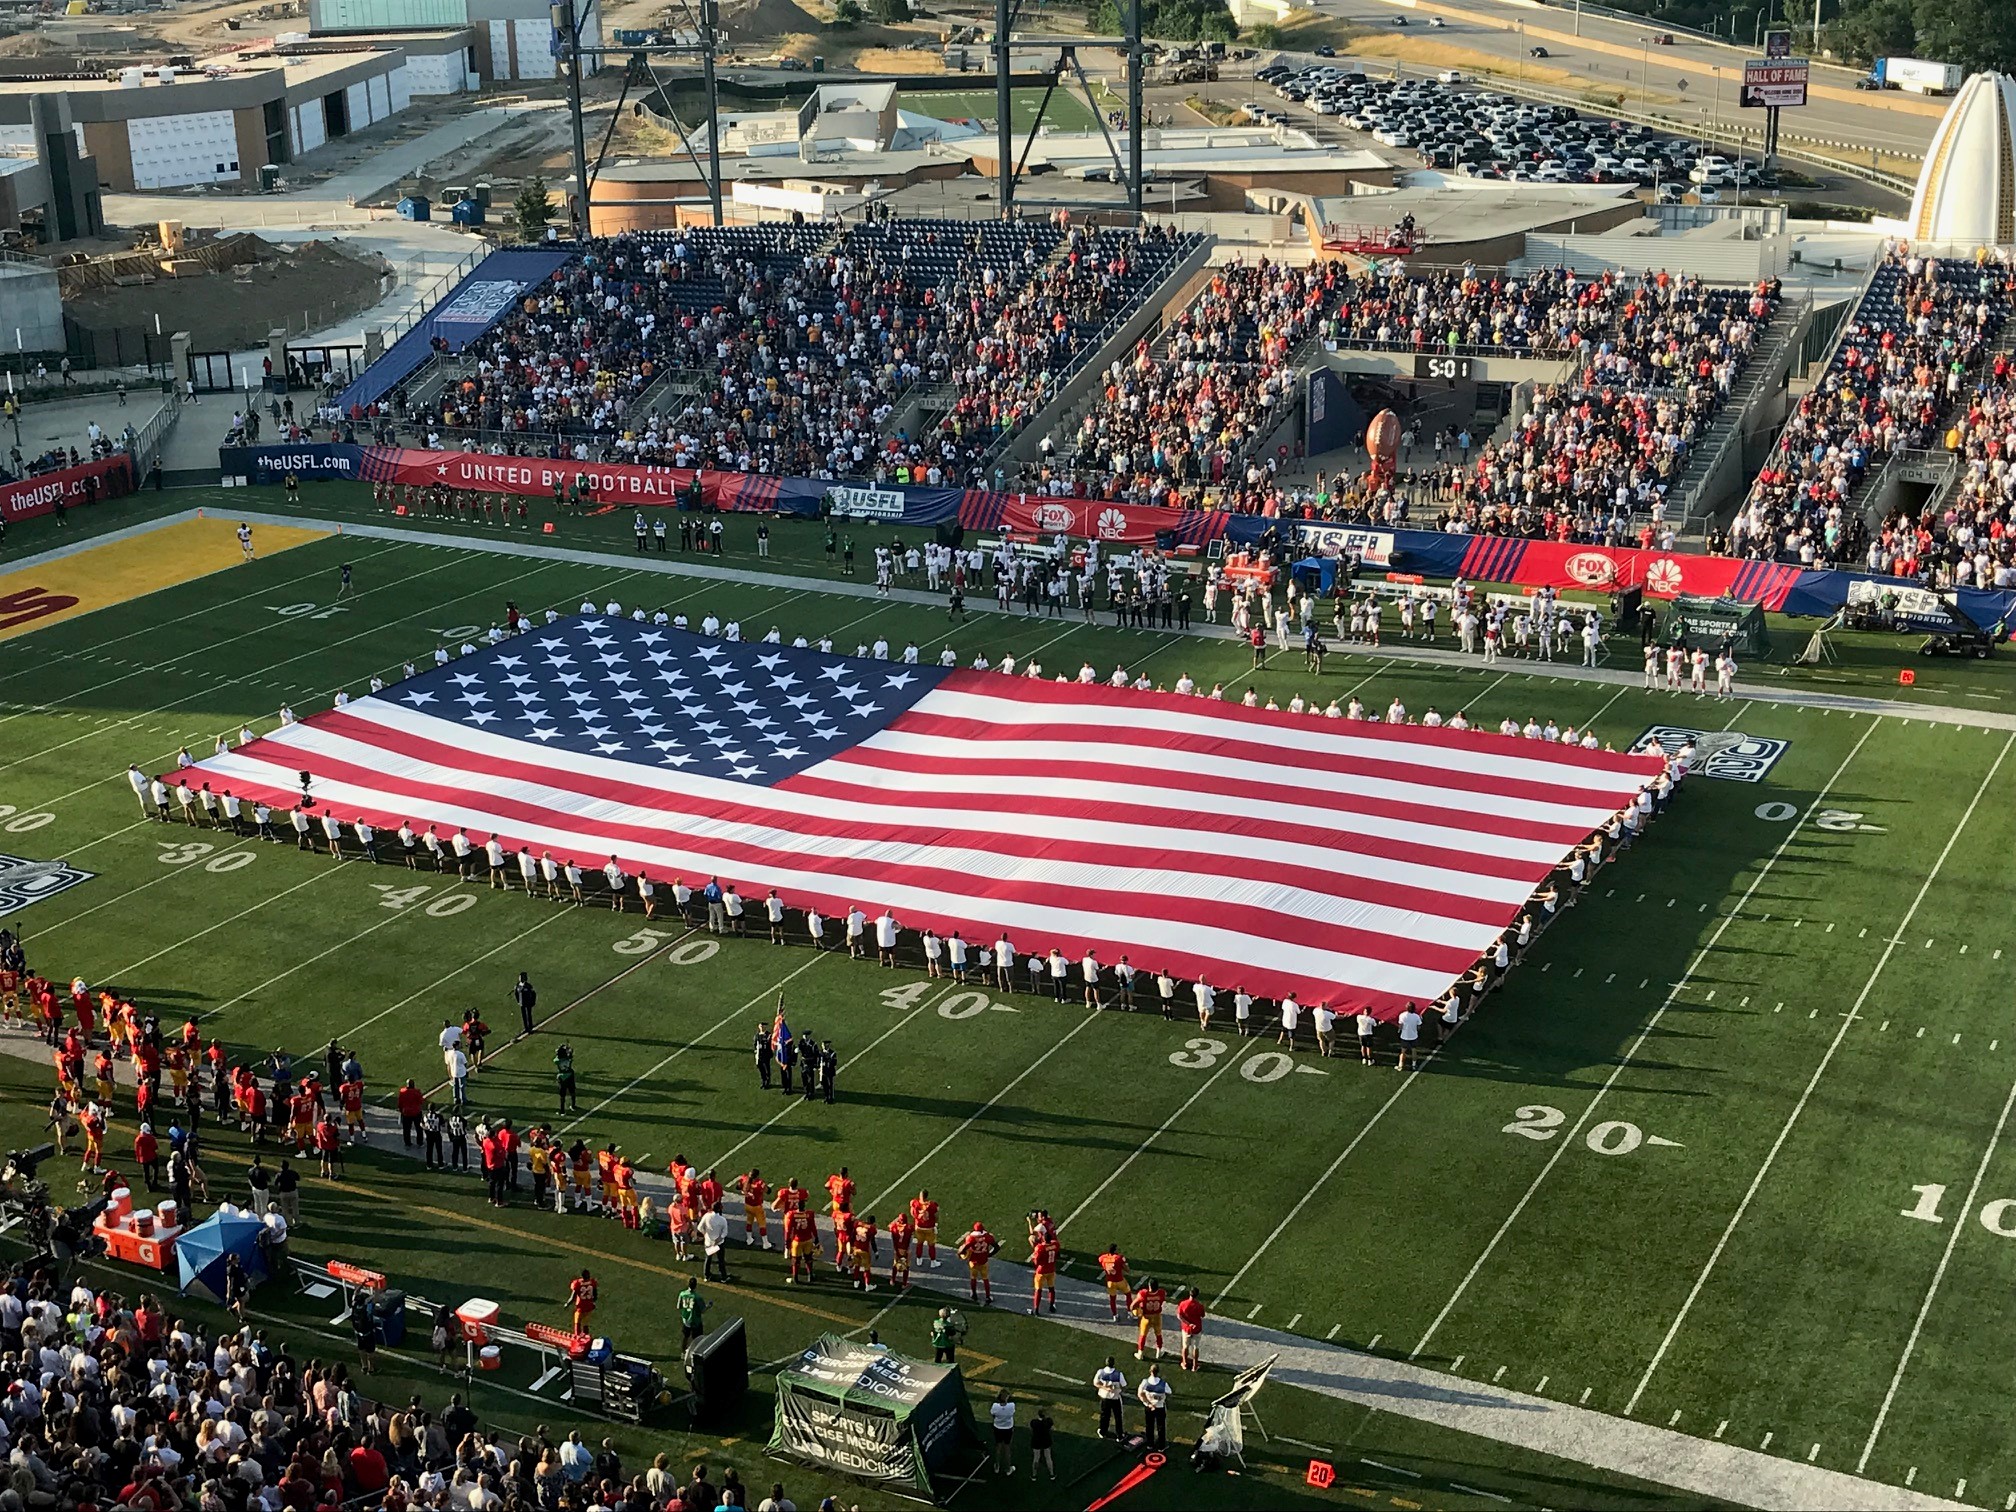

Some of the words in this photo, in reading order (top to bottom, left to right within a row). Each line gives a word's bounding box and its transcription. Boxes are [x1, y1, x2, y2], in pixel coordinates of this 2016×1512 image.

[1747, 70, 1769, 83] HALL
[1770, 69, 1782, 82] OF
[1784, 68, 1807, 81] FAME
[1428, 358, 1468, 378] 5:01
[257, 455, 351, 471] theUSFL.com
[460, 463, 533, 485] UNITED
[541, 470, 567, 487] BY
[853, 492, 901, 510] USFL
[1042, 508, 1066, 522] FOX
[1098, 527, 1125, 540] NBC
[1298, 529, 1387, 562] USFL
[1074, 555, 1082, 564] G
[1576, 558, 1606, 574] FOX
[1647, 578, 1680, 594] NBC
[1893, 612, 1954, 625] AMPIONSHIP
[157, 841, 258, 873] 30
[378, 884, 479, 918] 40
[611, 927, 721, 966] 50
[879, 980, 993, 1020] 40
[1168, 1037, 1295, 1083] 30
[1501, 1104, 1642, 1156] 20
[1900, 1182, 2016, 1238] 10
[138, 1243, 155, 1263] G
[463, 1321, 478, 1338] G
[803, 1350, 870, 1369] EXERCISE
[868, 1361, 939, 1390] MEDICINE
[845, 1351, 900, 1369] SPORTS
[898, 1364, 911, 1375] &
[833, 1371, 918, 1401] MEDICINE
[811, 1409, 866, 1435] SPORTS
[866, 1425, 877, 1438] &
[825, 1448, 907, 1476] MEDICINE
[1310, 1464, 1329, 1484] 20
